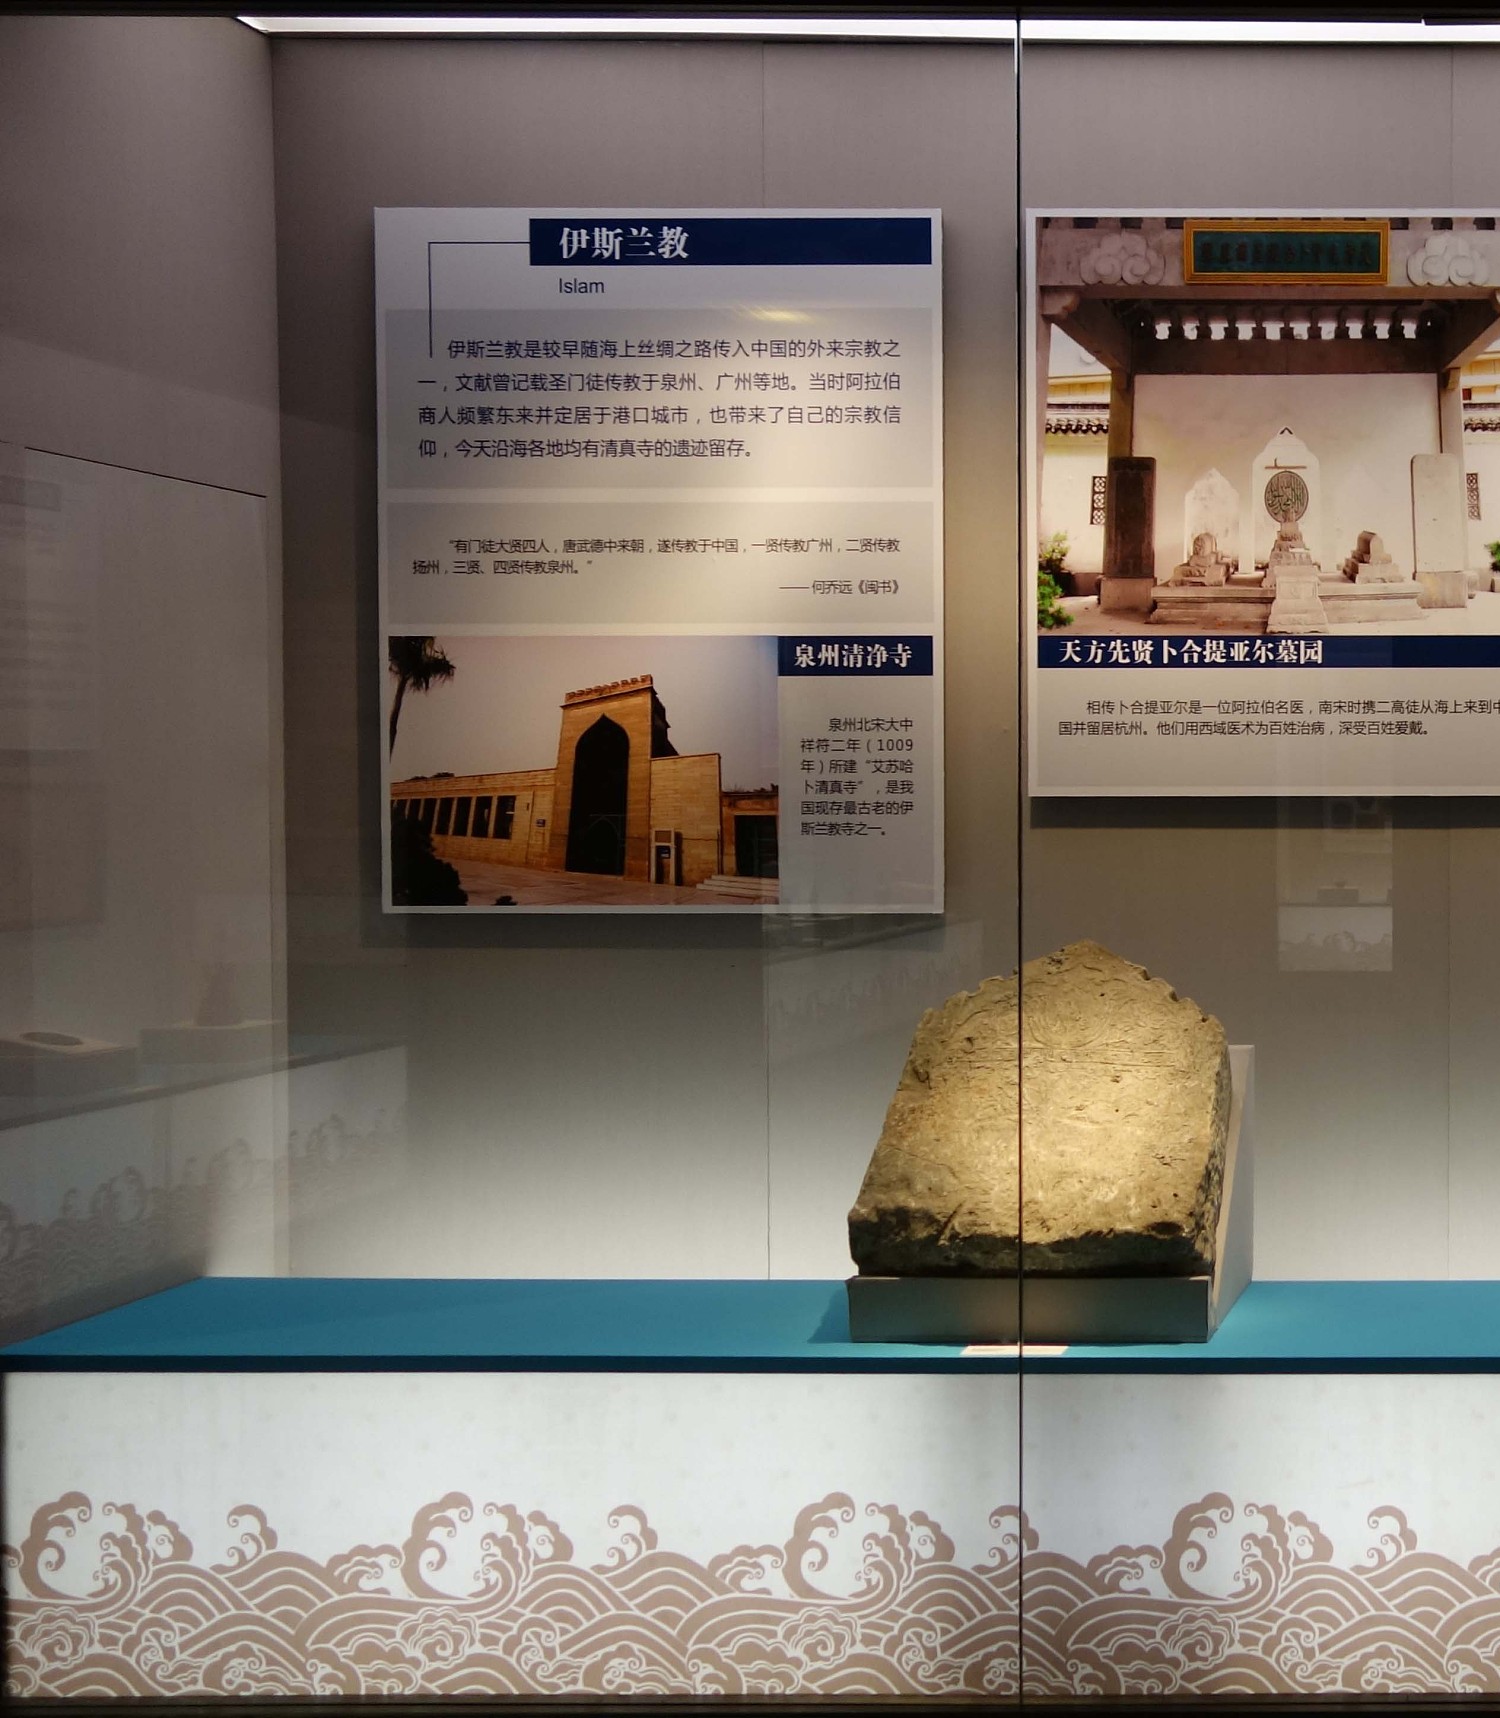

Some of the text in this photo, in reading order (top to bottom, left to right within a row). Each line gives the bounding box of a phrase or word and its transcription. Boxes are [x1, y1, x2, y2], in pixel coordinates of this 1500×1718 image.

[560, 227, 688, 259] 伊斯兰教
[559, 278, 604, 294] Islam
[446, 338, 900, 359] 伊斯兰教是较早随海上丝绸之路传入中国的外来宗教之
[418, 405, 901, 426] 商人频繁东来并定居于港口城市，也带来了自己的宗教信
[418, 438, 754, 458] 仰，今天沿海各地均有清真寺的遗迹留存。
[796, 644, 911, 667] 泉州清净寺
[1058, 640, 1323, 665] 天方先贤卜合提亚尔墓园
[828, 717, 913, 732] 泉州北宋大中
[1058, 721, 1428, 735] 国并留居杭州。他们用西域医术为百姓治病，深受百姓爱戴。
[801, 801, 914, 815] 国现存最古老的伊
[801, 822, 885, 837] 斯兰教寺之一。
